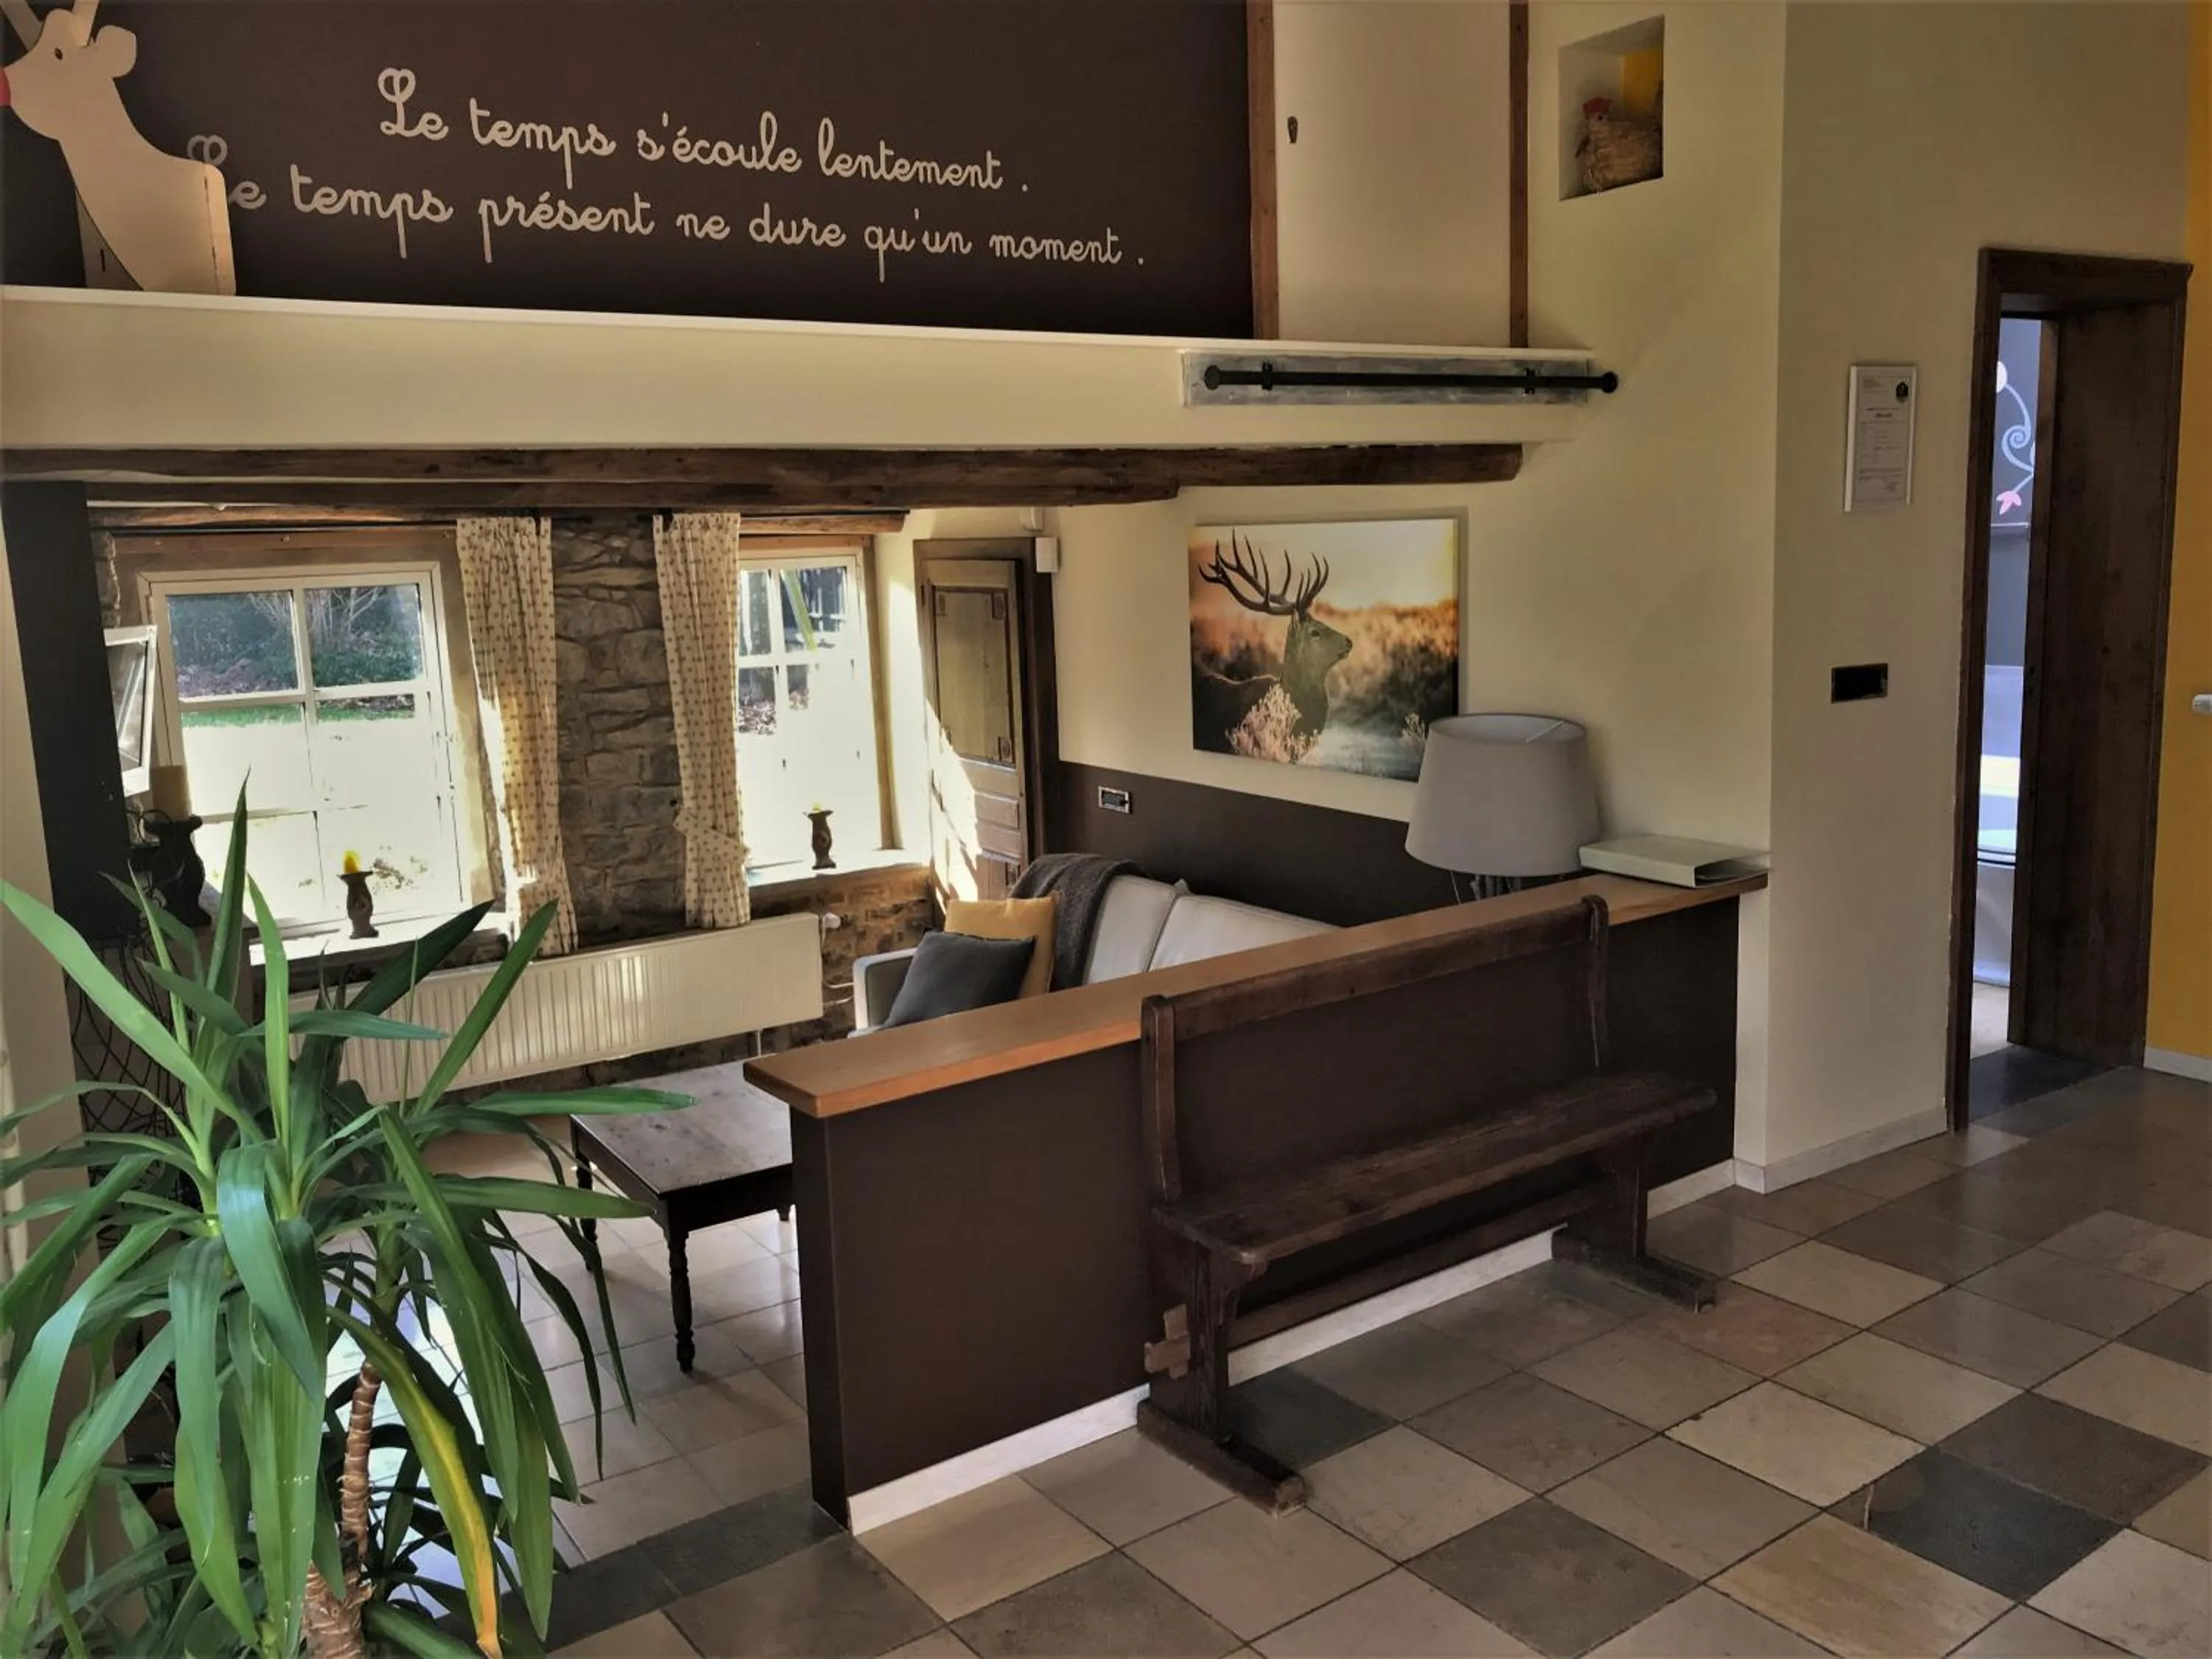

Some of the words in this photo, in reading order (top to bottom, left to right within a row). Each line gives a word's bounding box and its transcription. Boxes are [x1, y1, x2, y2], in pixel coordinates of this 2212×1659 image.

[377, 67, 449, 141] Le
[469, 97, 617, 189] temps
[636, 111, 803, 173] s'écoule
[290, 164, 454, 259] temps
[478, 191, 655, 263] présent
[675, 213, 731, 240] ne
[748, 202, 847, 248] dure
[863, 207, 973, 283] qu'un
